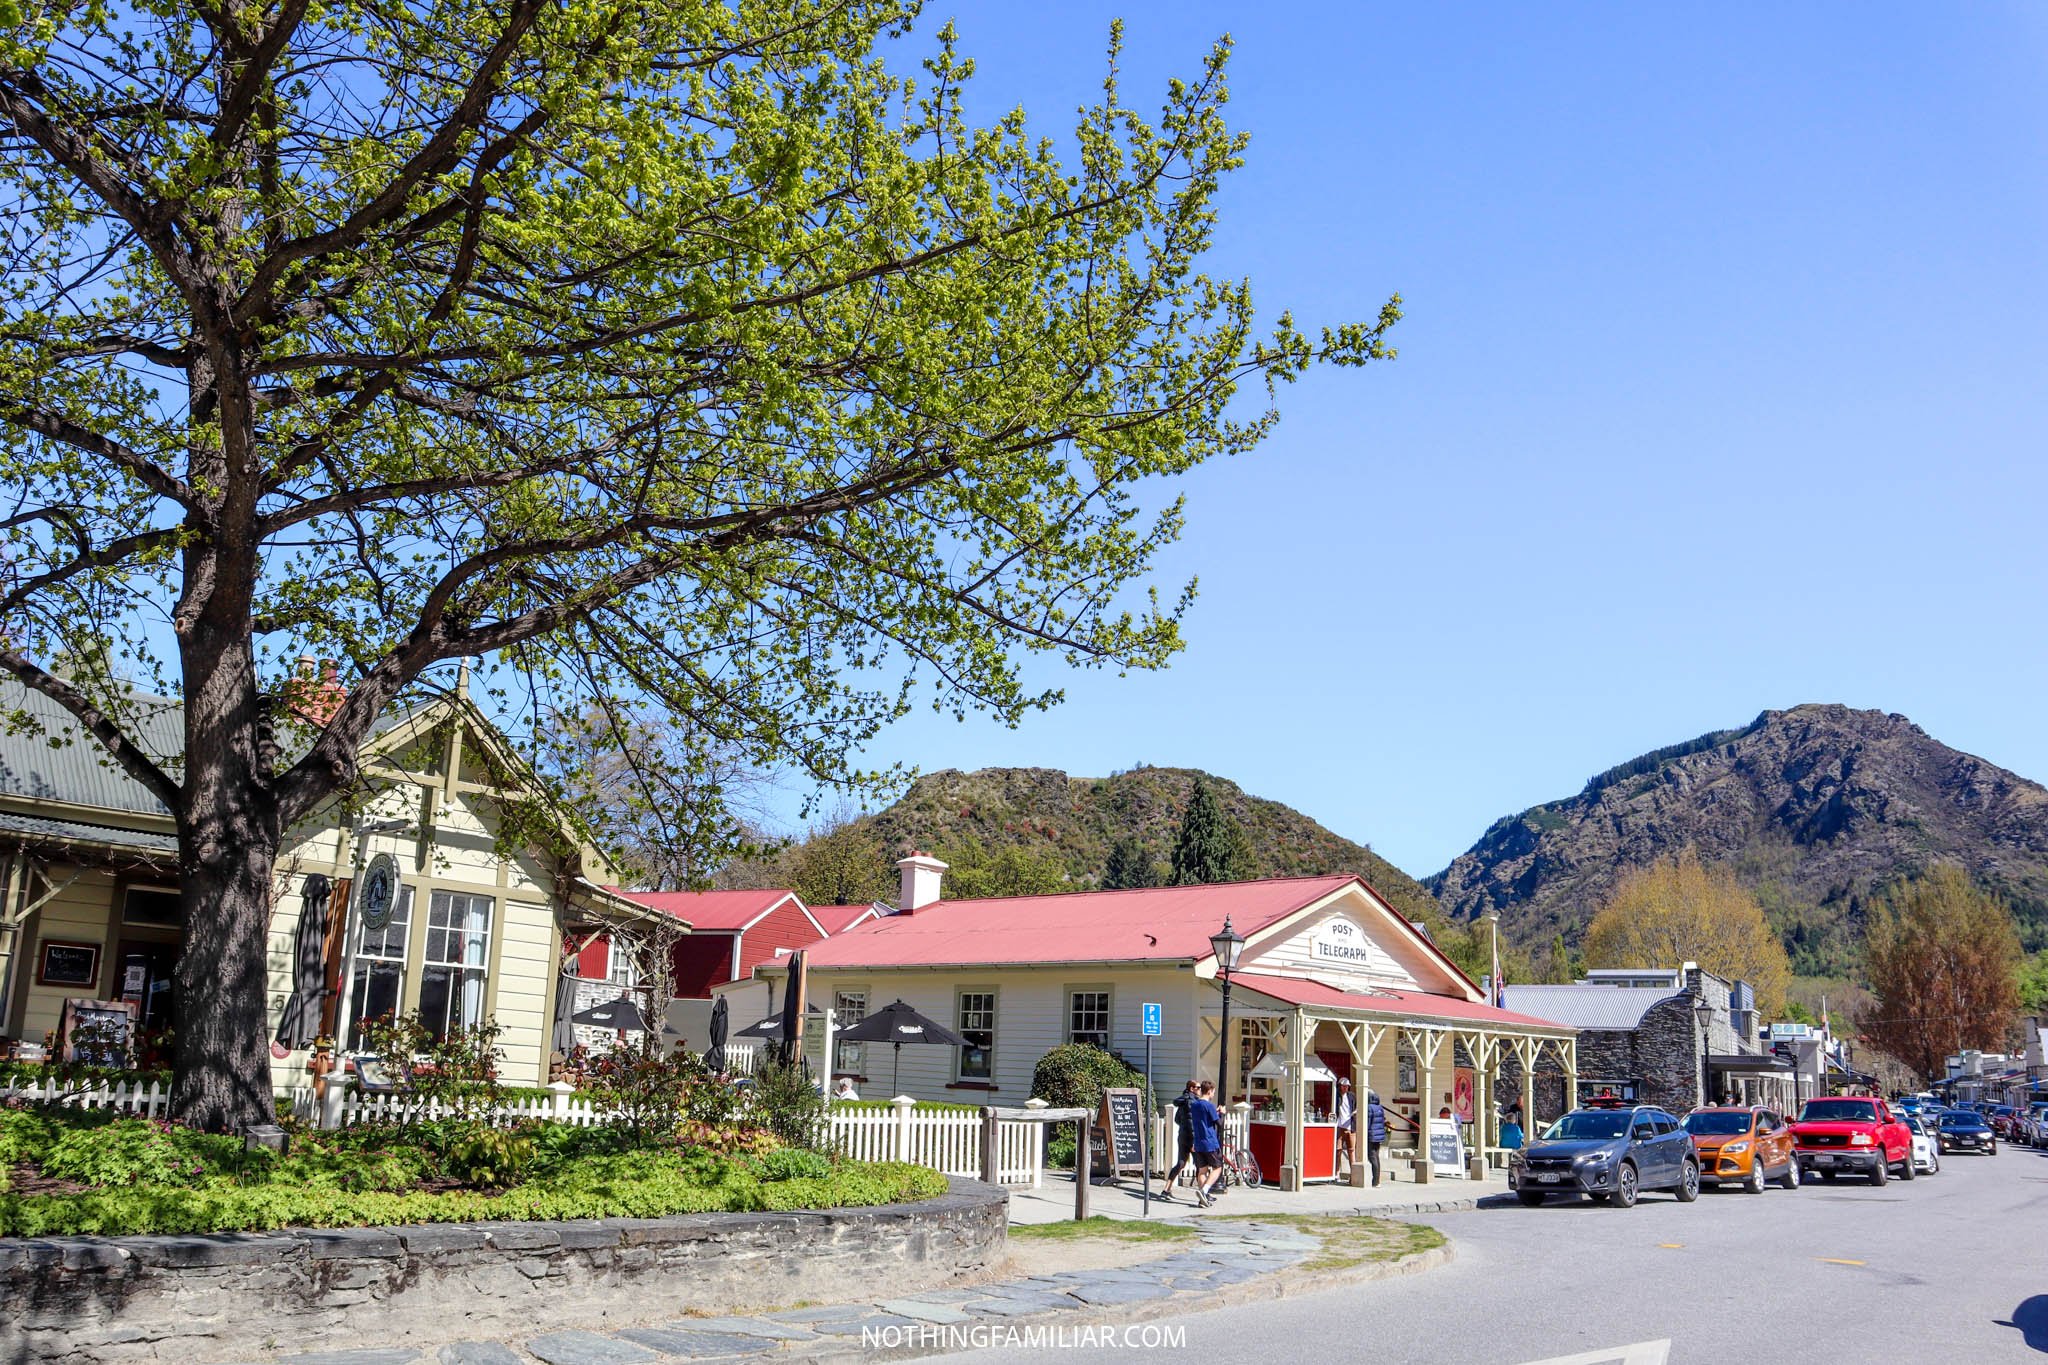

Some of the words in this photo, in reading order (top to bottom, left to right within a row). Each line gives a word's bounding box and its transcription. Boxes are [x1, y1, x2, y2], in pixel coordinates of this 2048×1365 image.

[1332, 924, 1353, 936] POST
[1318, 942, 1367, 961] TELEGRAPH
[275, 995, 285, 1009] 5
[1150, 1006, 1155, 1014] P
